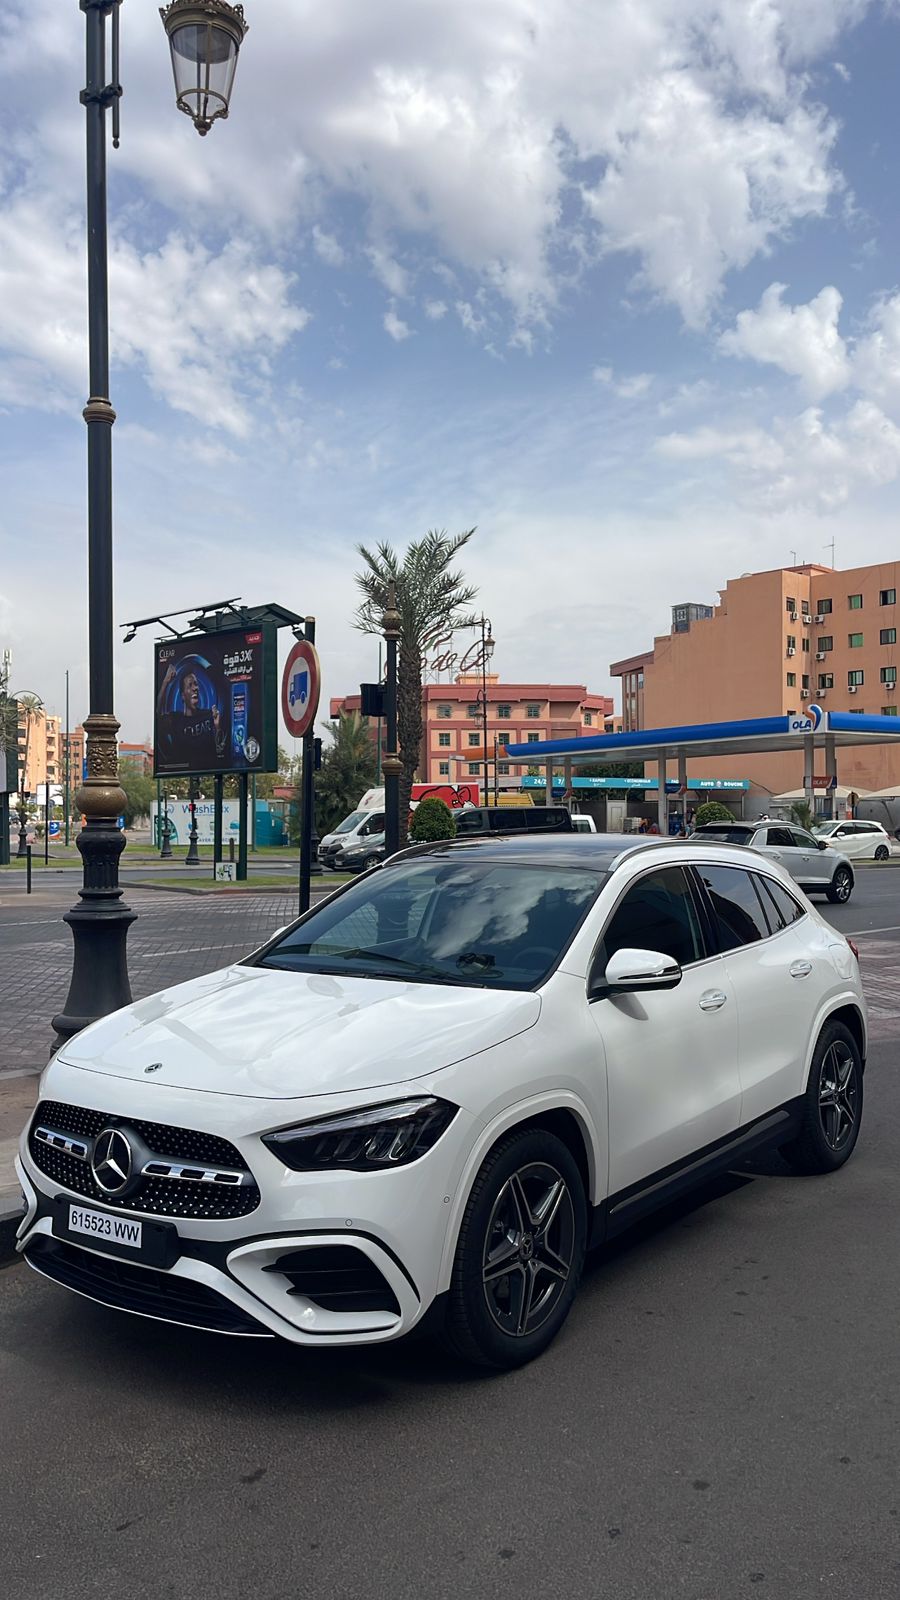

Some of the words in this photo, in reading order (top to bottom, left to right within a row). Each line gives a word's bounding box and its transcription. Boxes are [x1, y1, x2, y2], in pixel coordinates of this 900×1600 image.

[159, 649, 176, 658] CLEAR
[792, 719, 812, 729] OLA
[182, 804, 230, 814] WashBx
[71, 1210, 112, 1235] 615523
[113, 1221, 140, 1242] WW
